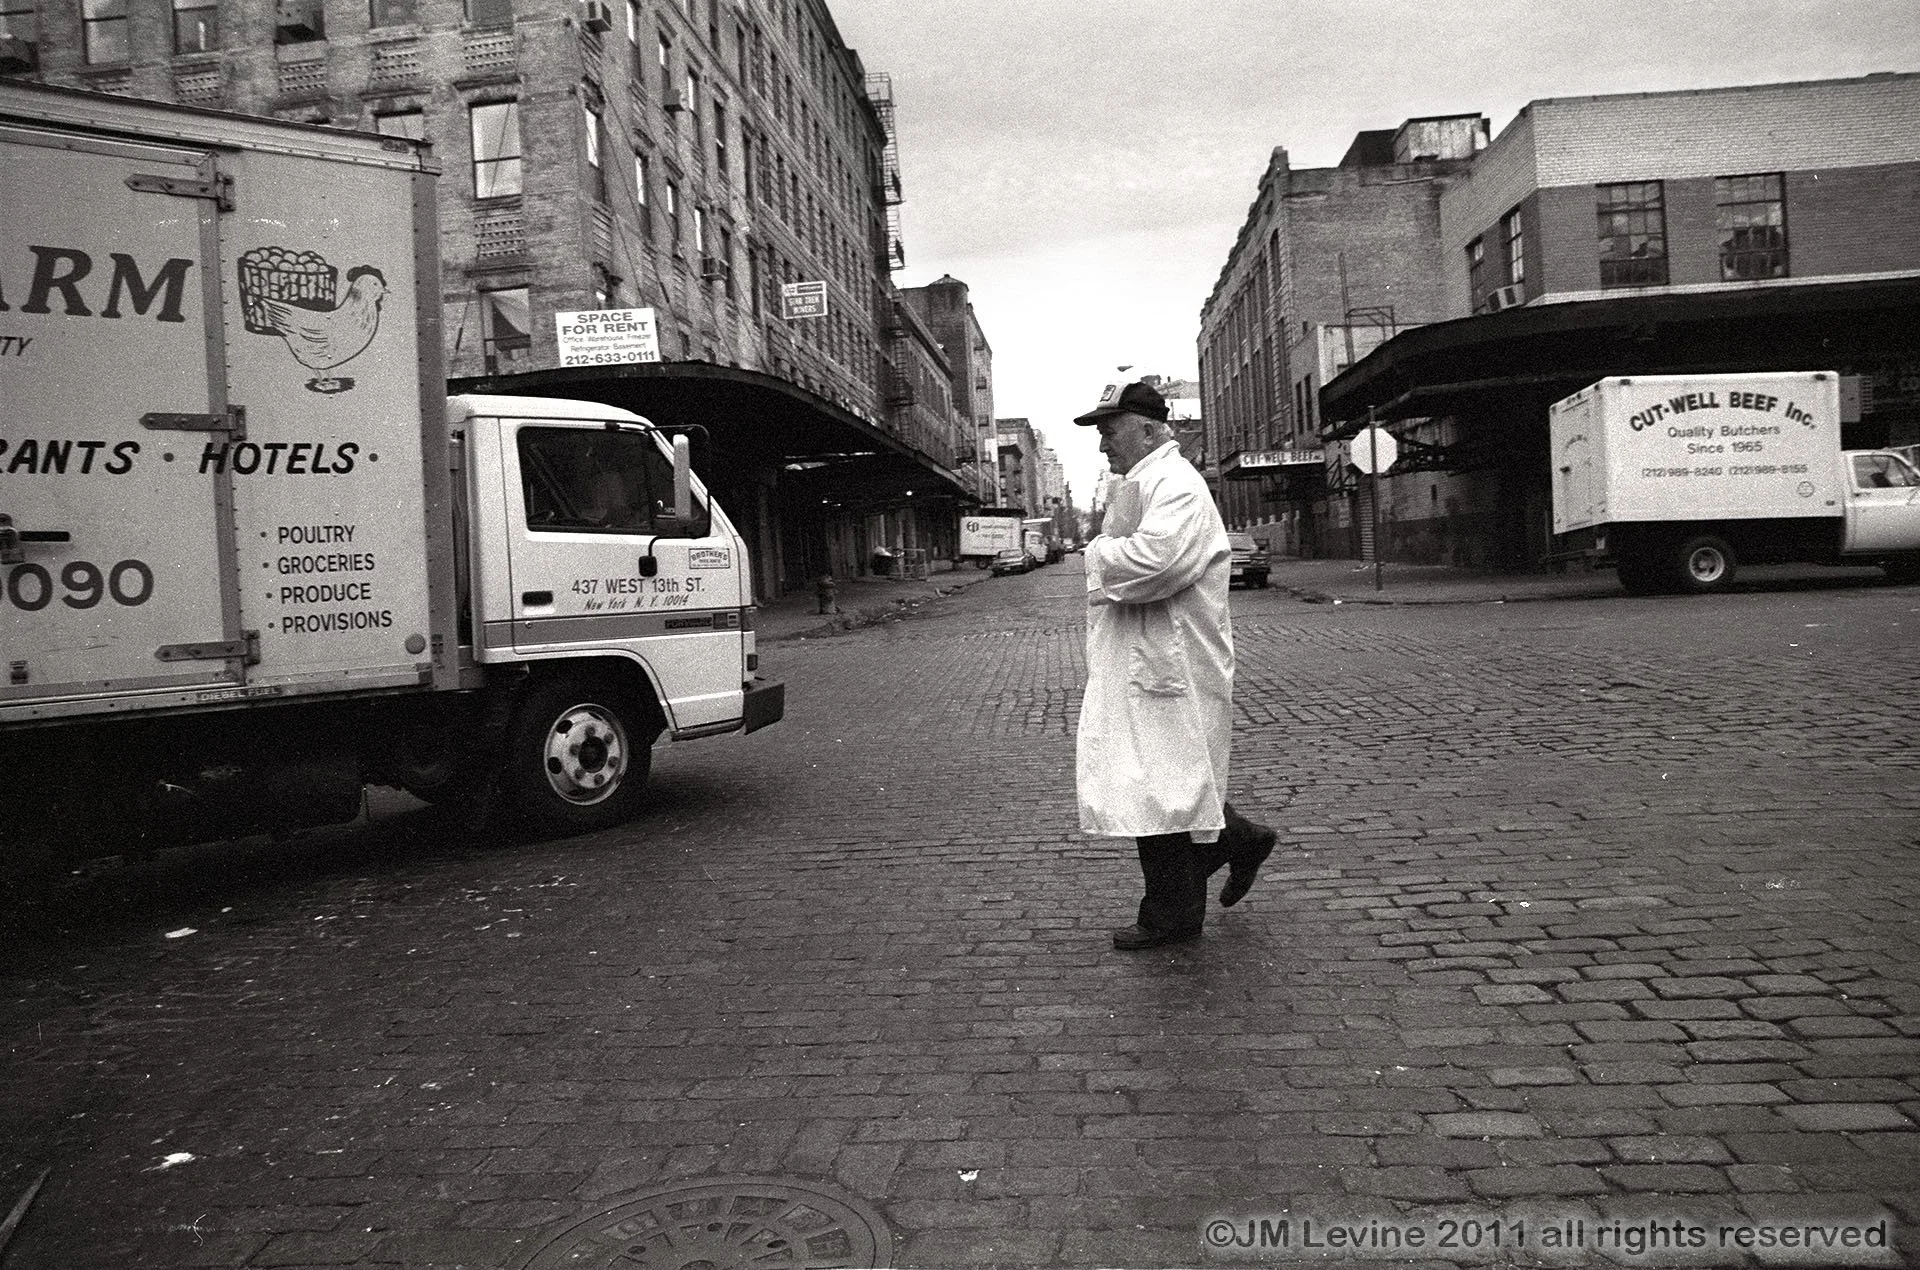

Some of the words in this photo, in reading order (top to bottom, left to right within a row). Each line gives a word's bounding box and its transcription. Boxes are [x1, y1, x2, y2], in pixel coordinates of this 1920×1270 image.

[0, 245, 194, 322] RM
[577, 312, 633, 323] SPACE
[562, 324, 597, 335] FOR
[604, 322, 648, 333] RENT
[0, 336, 33, 356] TY
[1729, 391, 1778, 412] BEEF
[1785, 401, 1818, 430] Inc.
[1667, 426, 1714, 439] Quality
[1721, 425, 1781, 436] Butchers
[1687, 442, 1724, 454] Since
[1731, 441, 1763, 452] 1965
[199, 442, 360, 475] HOTELS
[278, 525, 355, 544] POULTRY
[278, 553, 375, 574] GROCERIES
[0, 559, 154, 611] 090
[281, 583, 372, 604] PRODUCE
[572, 579, 598, 594] 437
[605, 578, 645, 593] WEST
[652, 578, 679, 593] 13th
[686, 577, 705, 592] ST.
[584, 598, 603, 611] New
[607, 597, 627, 609] York
[663, 594, 689, 606] 10014
[282, 610, 393, 634] PROVISIONS
[201, 689, 246, 701] DIESEL
